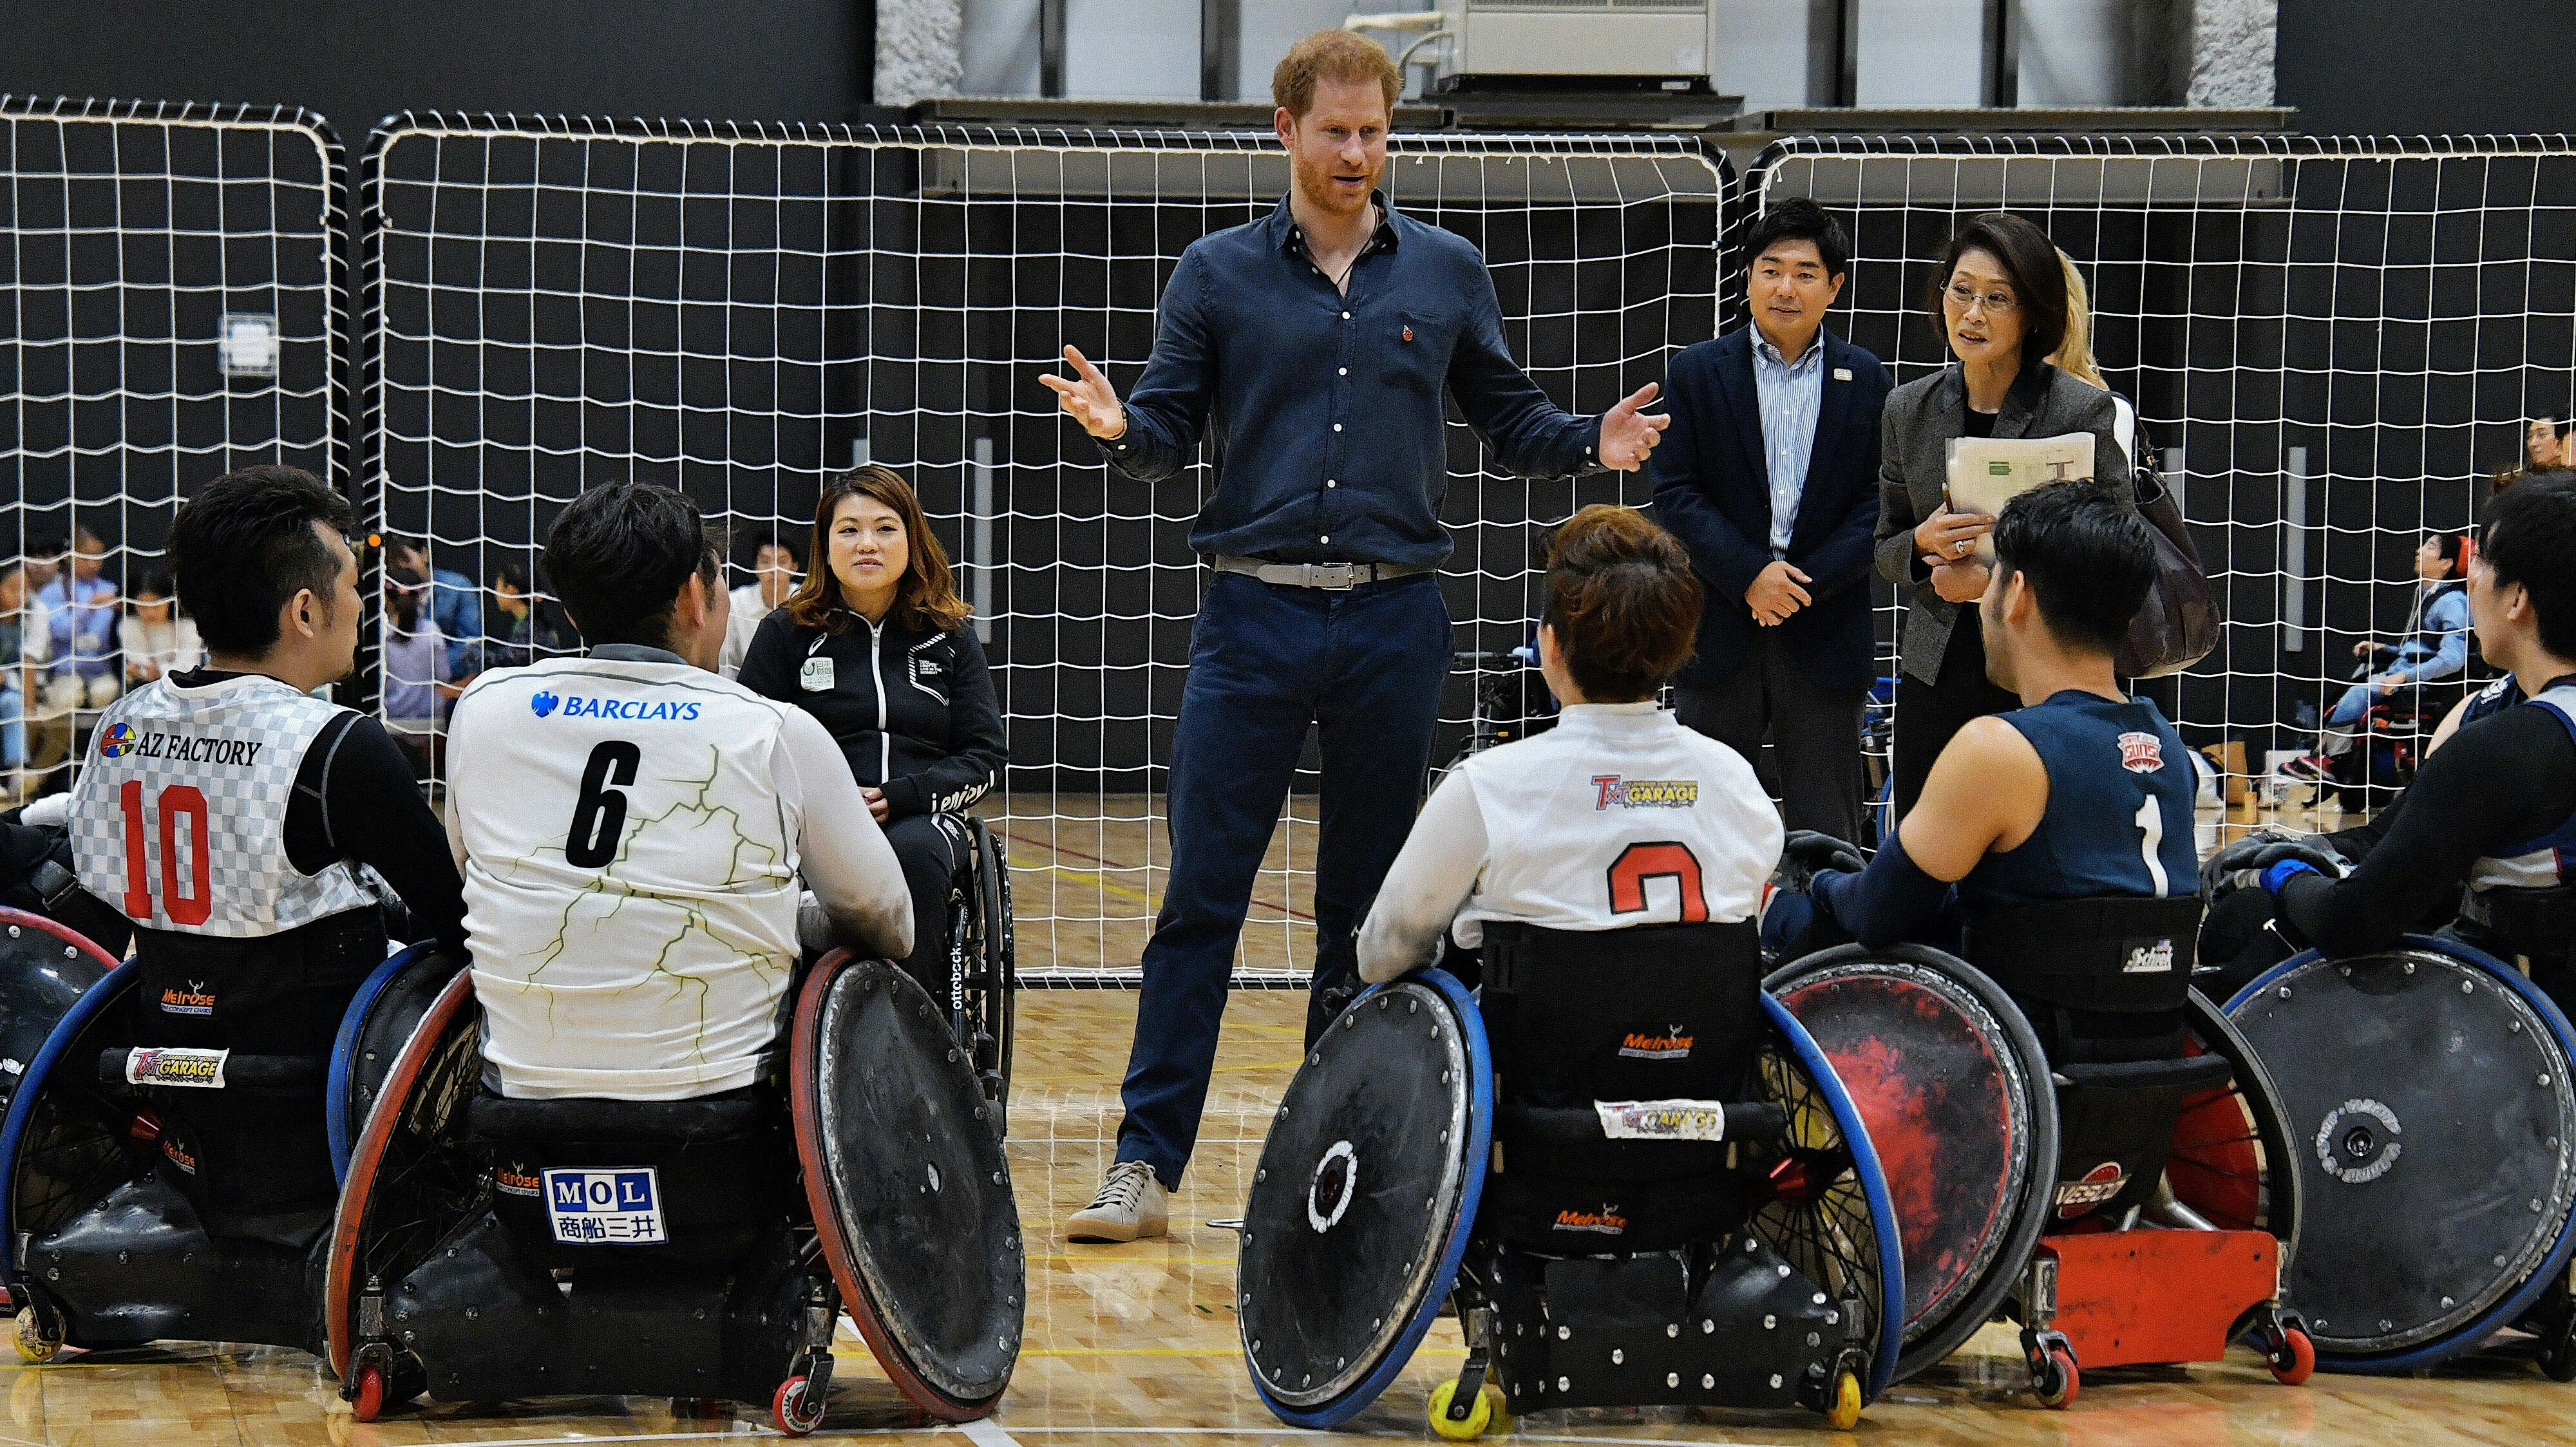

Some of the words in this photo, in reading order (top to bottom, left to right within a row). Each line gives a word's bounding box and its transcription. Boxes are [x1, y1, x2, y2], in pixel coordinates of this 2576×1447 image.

[563, 696, 701, 721] BARCLAYS
[135, 732, 164, 758] AZ
[165, 735, 263, 766] FACTORY
[565, 741, 641, 869] 6
[1628, 786, 1698, 802] GARAGE
[120, 780, 212, 926] 10
[2136, 793, 2169, 899] 1
[159, 1060, 217, 1077] GARAGE
[556, 1181, 645, 1205] MOL
[558, 1215, 656, 1239] 商船三井
